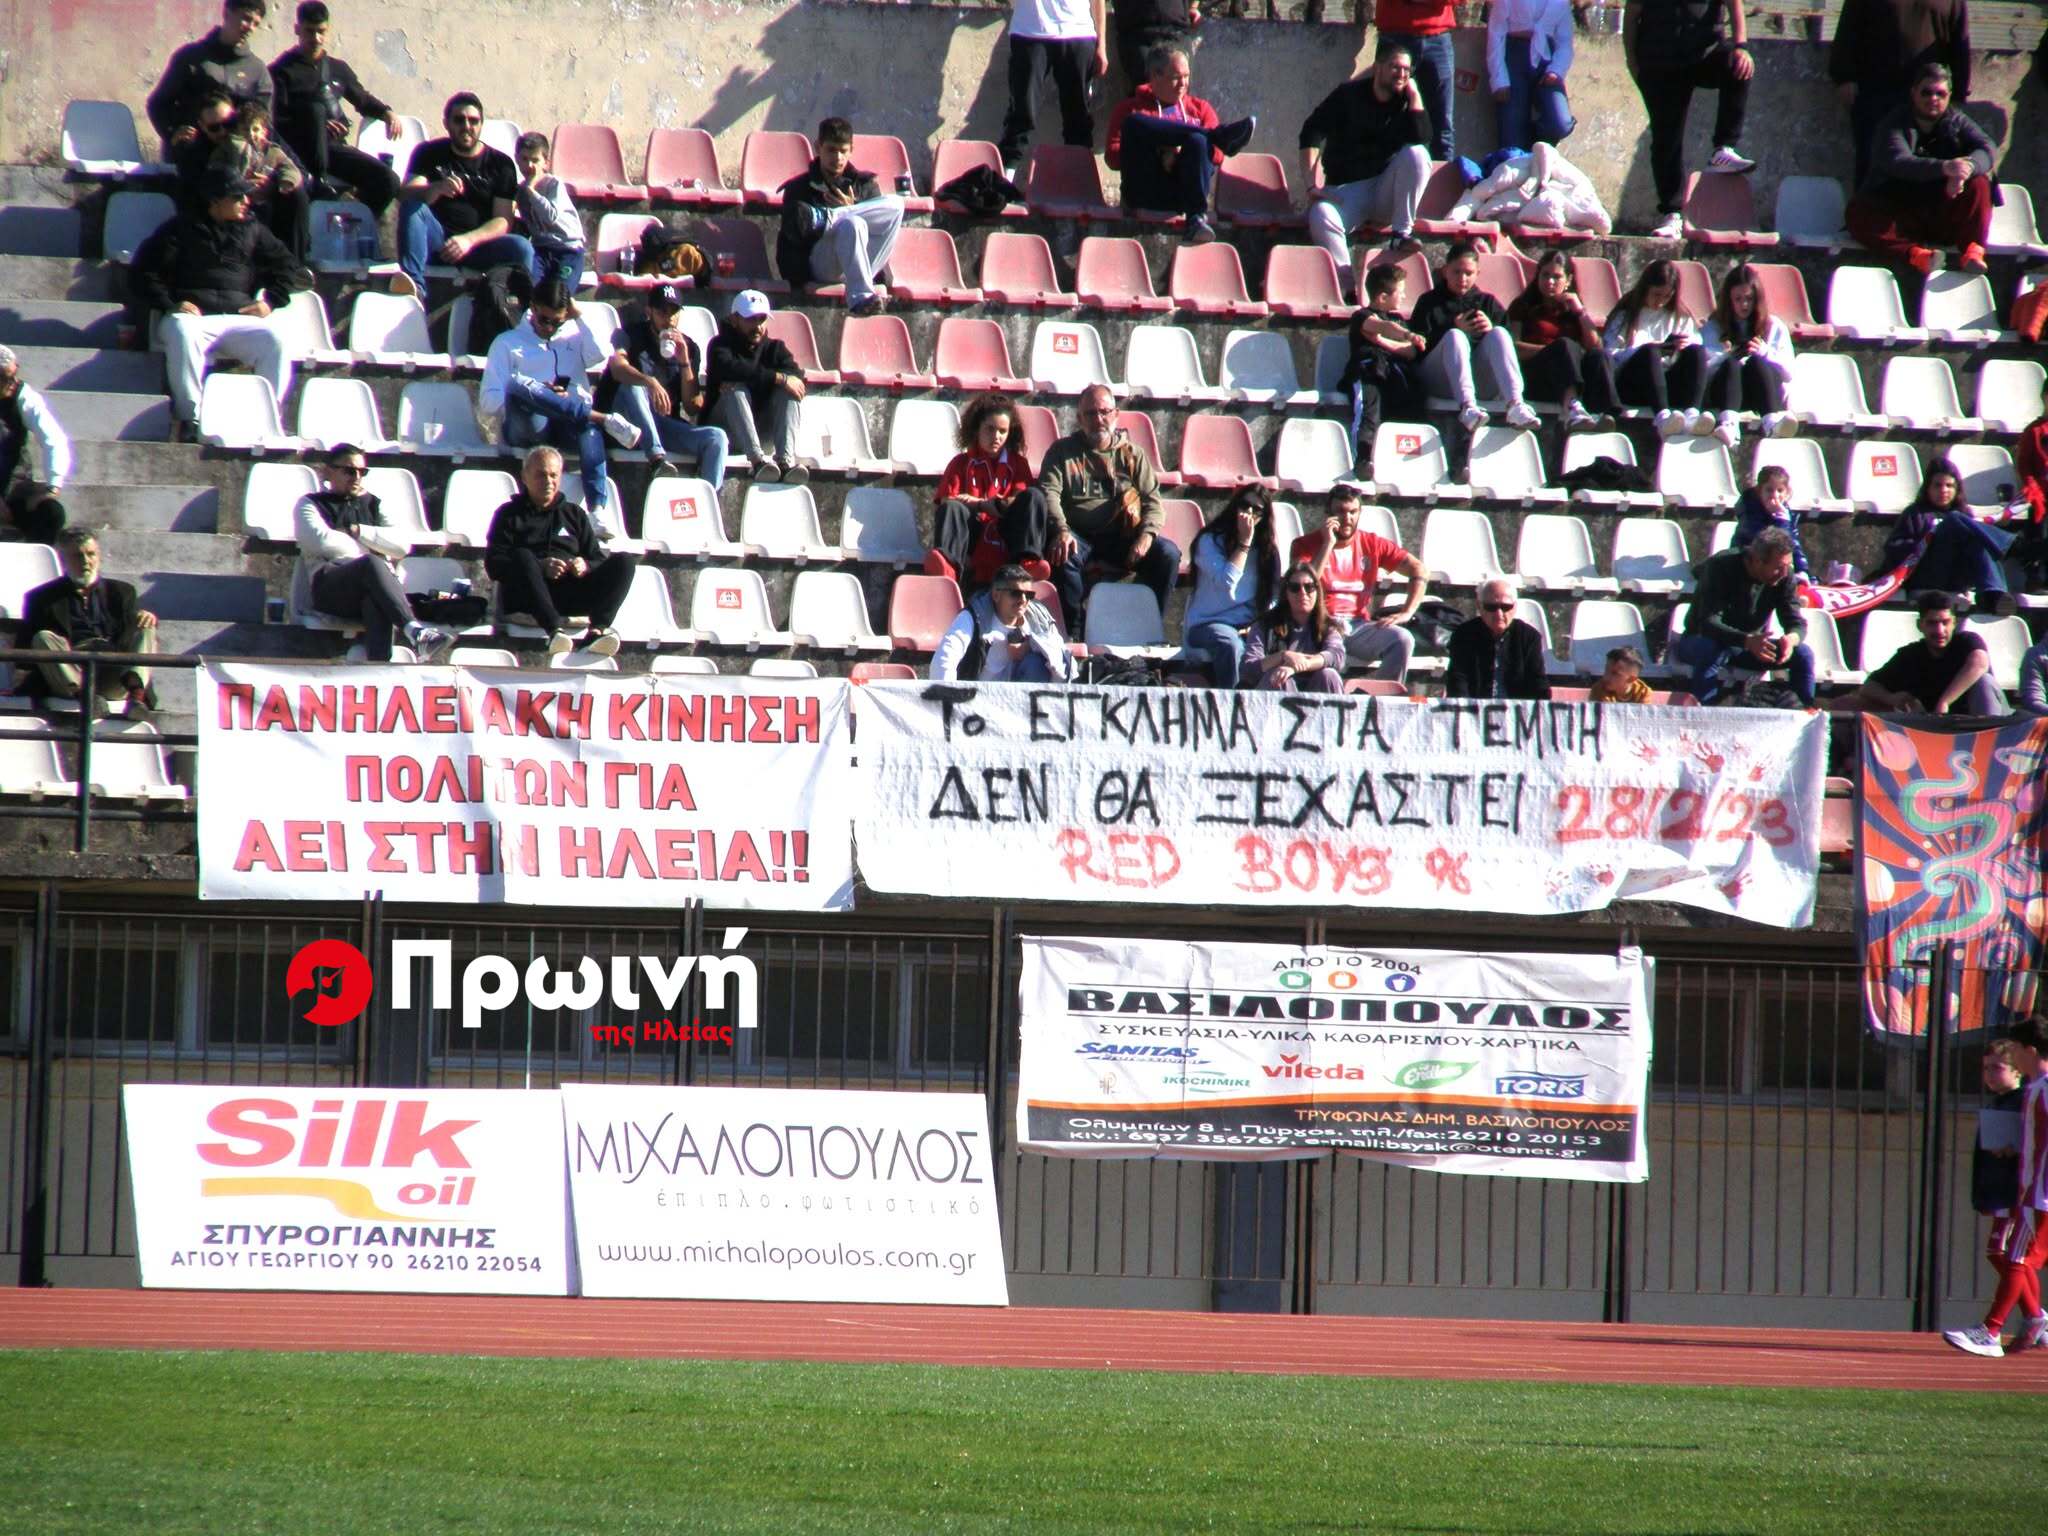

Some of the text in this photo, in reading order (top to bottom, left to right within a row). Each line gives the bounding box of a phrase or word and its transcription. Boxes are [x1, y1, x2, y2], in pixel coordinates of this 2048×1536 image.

[217, 683, 821, 744] ΠΑΝΗΛΕΙΑΚΗ ΚΙΝΗΣΗ
[1029, 688, 1259, 755] ΕΓΚΛΗΜΑ
[1281, 694, 1393, 754] ΣΤΑ
[1429, 700, 1602, 761] ΤΕΜΠΗ
[345, 755, 697, 812] ΠΟΛΙΤΩΝ ΓΙΑ
[928, 763, 1525, 835] ΔΕΝ ΘΑ ΞΕΧΑΣΤΕΙ
[1555, 784, 1796, 847] 28/2/23
[233, 819, 809, 883] ΑΕΙ ΣΤΗΝ ΗΛΕΙΑ!!
[1056, 828, 1182, 888] RED
[1232, 833, 1393, 896] BOYS
[1273, 956, 1325, 971] ΑΠΟ
[1371, 957, 1424, 976] 2004
[1067, 988, 1631, 1031] ΒΑΣΙΛΟΠΟΥΛΟΣ
[1074, 1041, 1200, 1058] SANITAS
[1262, 1054, 1365, 1081] vileda
[1498, 1078, 1582, 1097] TORK
[197, 1098, 481, 1168] Silk
[1069, 1118, 1192, 1133] Ολυμπίων
[1199, 1123, 1214, 1133] 8
[1528, 1133, 1601, 1146] 20153
[1295, 1109, 1631, 1133] ΤΡΥΦΩΝΑΣ ΔΗΜ. ΒΑΣΙΛΟΠΟΥΛΟΣ
[577, 1111, 983, 1184] ΜΙΧΑΛΟΠΟΥΛΟΣ
[397, 1176, 476, 1206] oil
[202, 1224, 497, 1249] ΣΠΥΡΟΓΙΑΝΝΗΣ
[170, 1251, 543, 1273] ΑΓΙΟΥ ΓΕΩΡΓΙΟΥ 90 26210 22054
[598, 1239, 977, 1276] www.michalopoulos.com.gr
